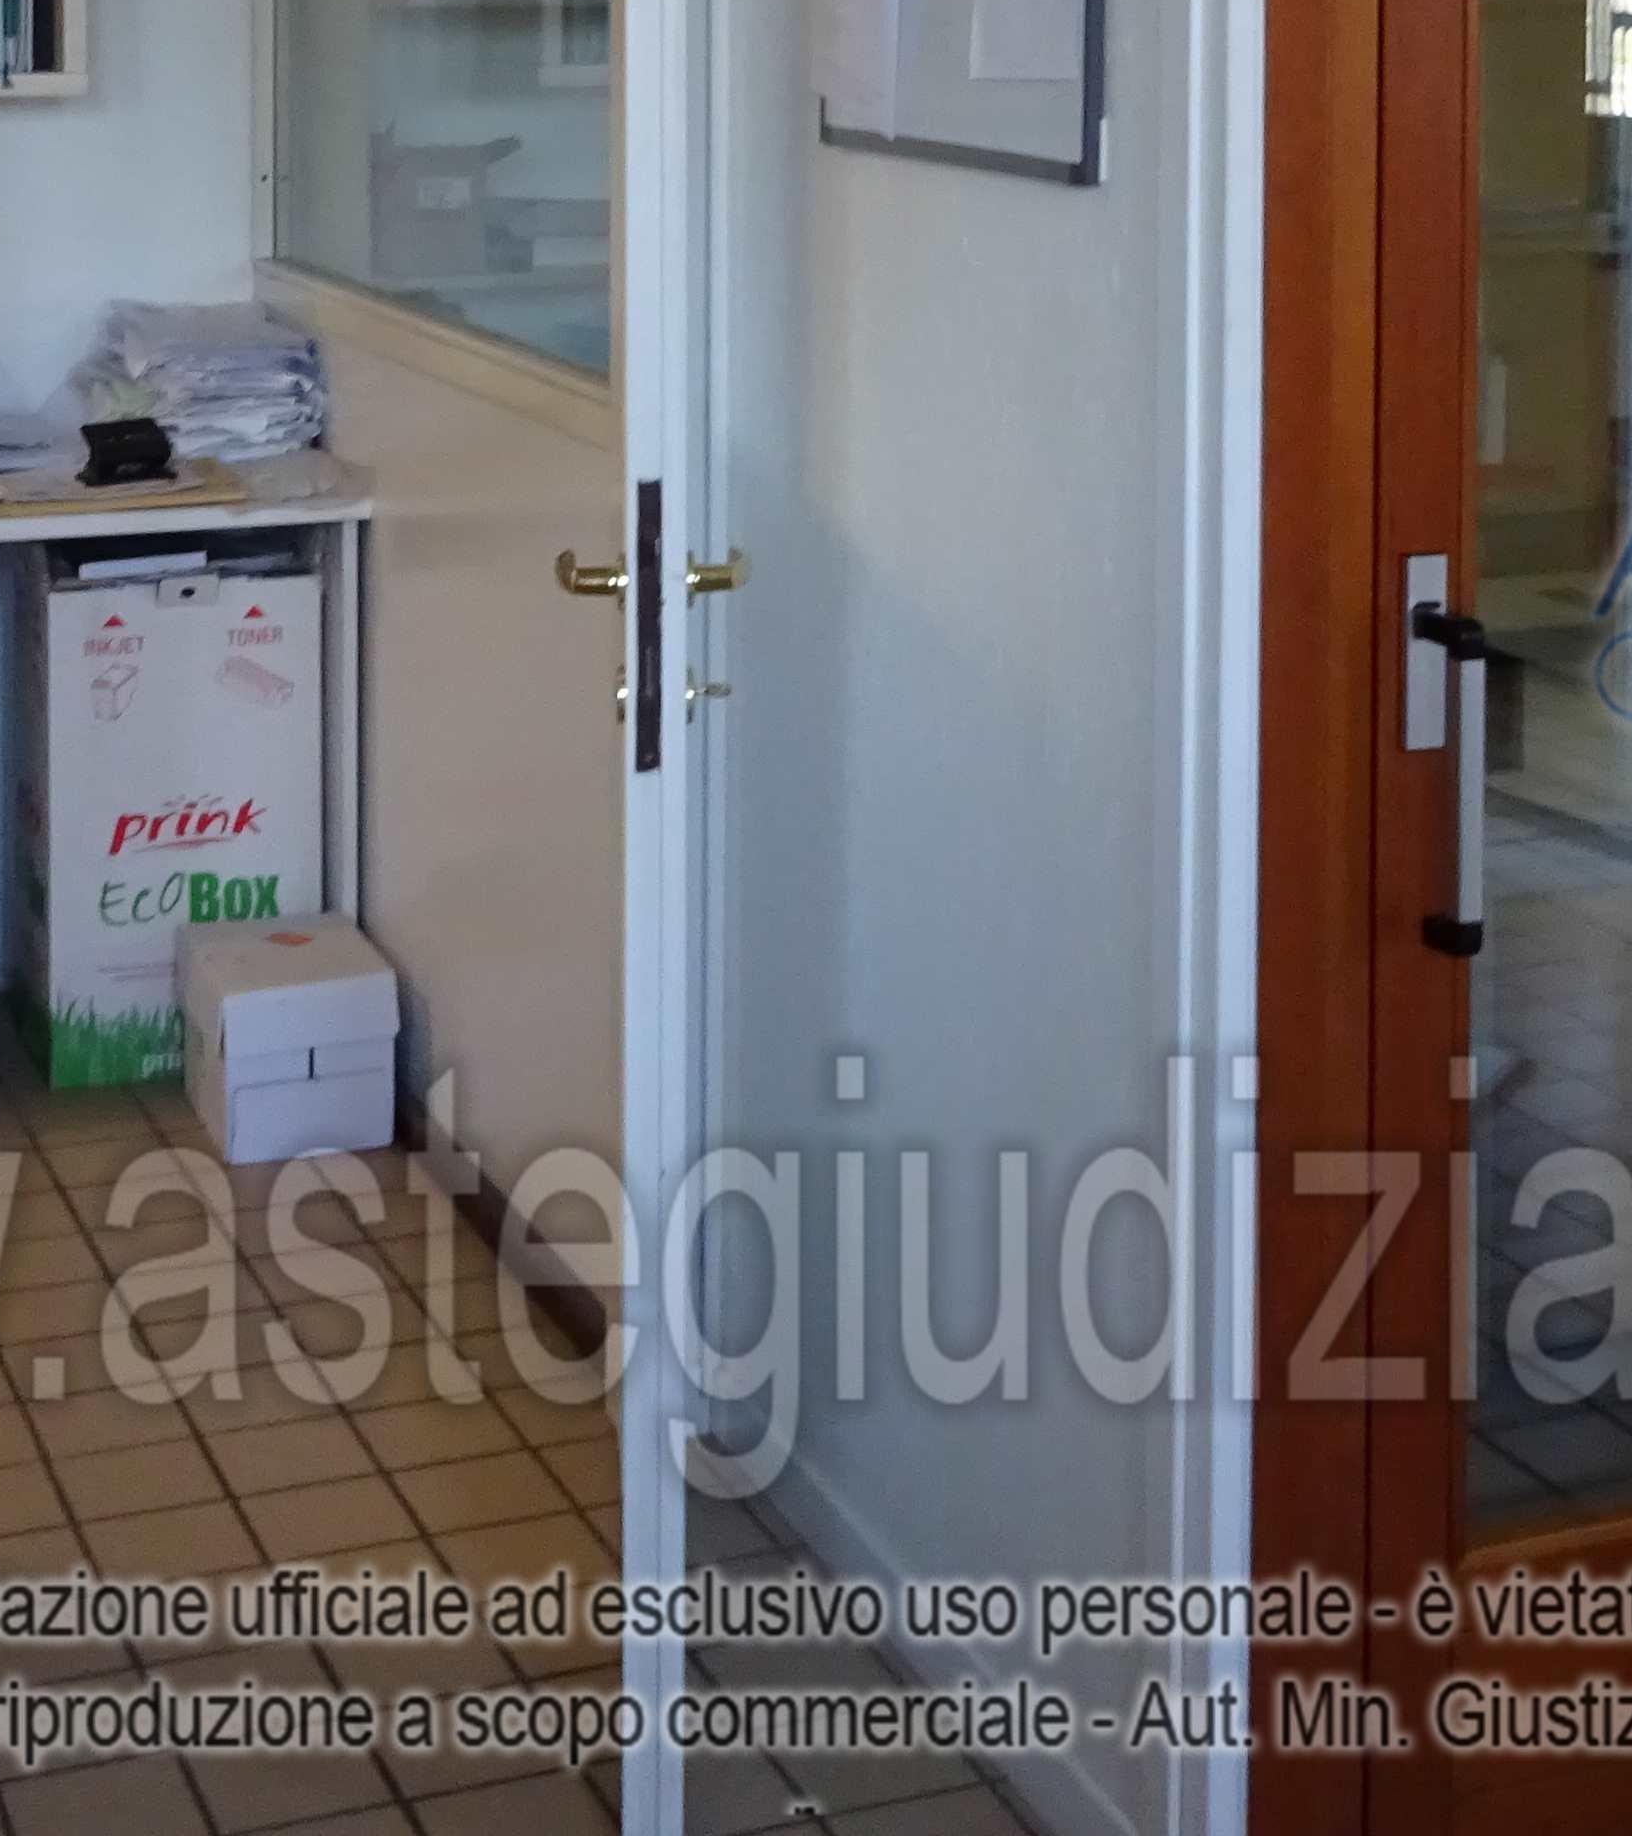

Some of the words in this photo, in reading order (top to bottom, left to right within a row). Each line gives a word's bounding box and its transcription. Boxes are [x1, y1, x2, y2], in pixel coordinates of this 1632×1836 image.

[81, 635, 145, 657] INKJET
[226, 626, 284, 647] TONER
[108, 798, 267, 856] prink
